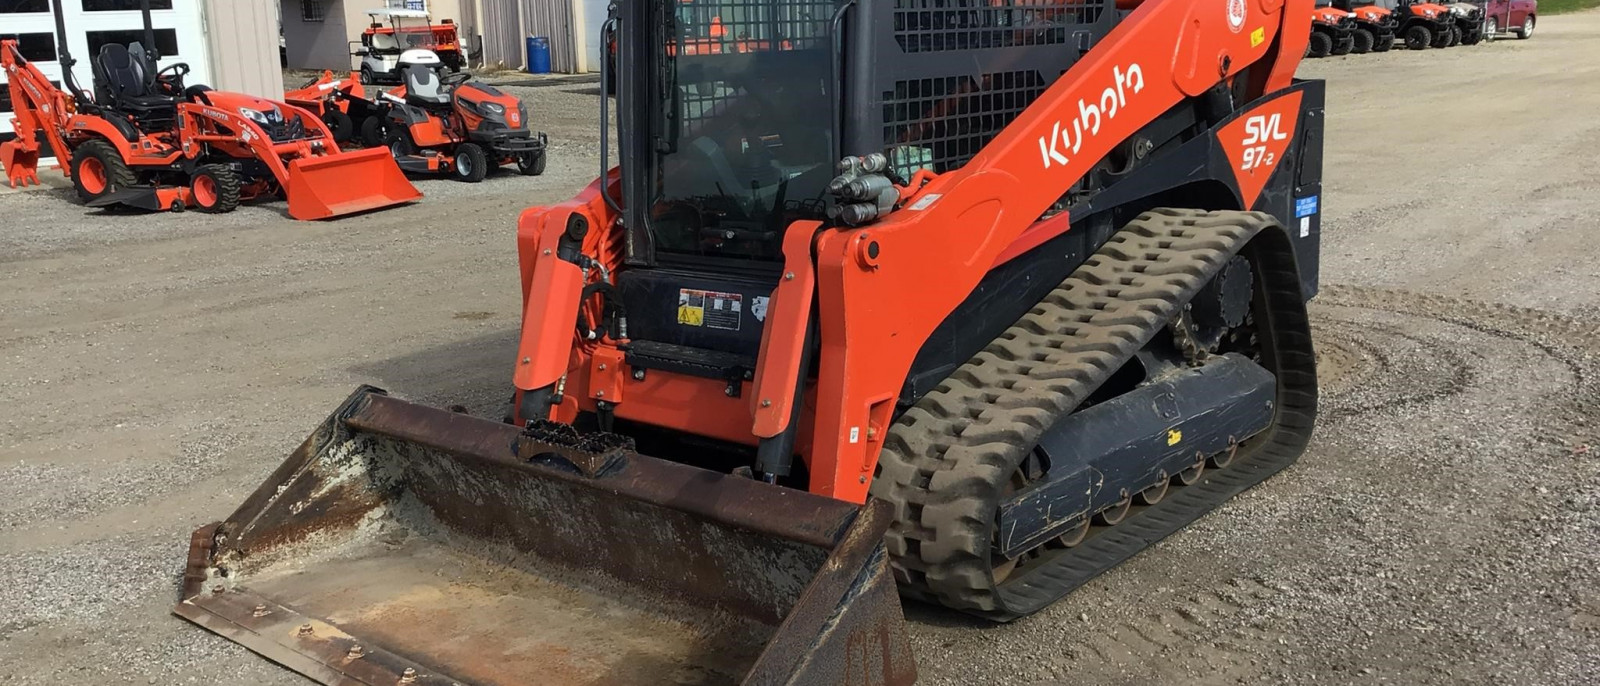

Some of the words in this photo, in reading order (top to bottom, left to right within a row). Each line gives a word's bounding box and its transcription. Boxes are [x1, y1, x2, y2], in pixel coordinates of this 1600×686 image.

[203, 108, 229, 121] KUBOTA
[1038, 63, 1144, 169] Kubota
[1242, 113, 1287, 145] SVL
[1241, 146, 1274, 170] 97-2
